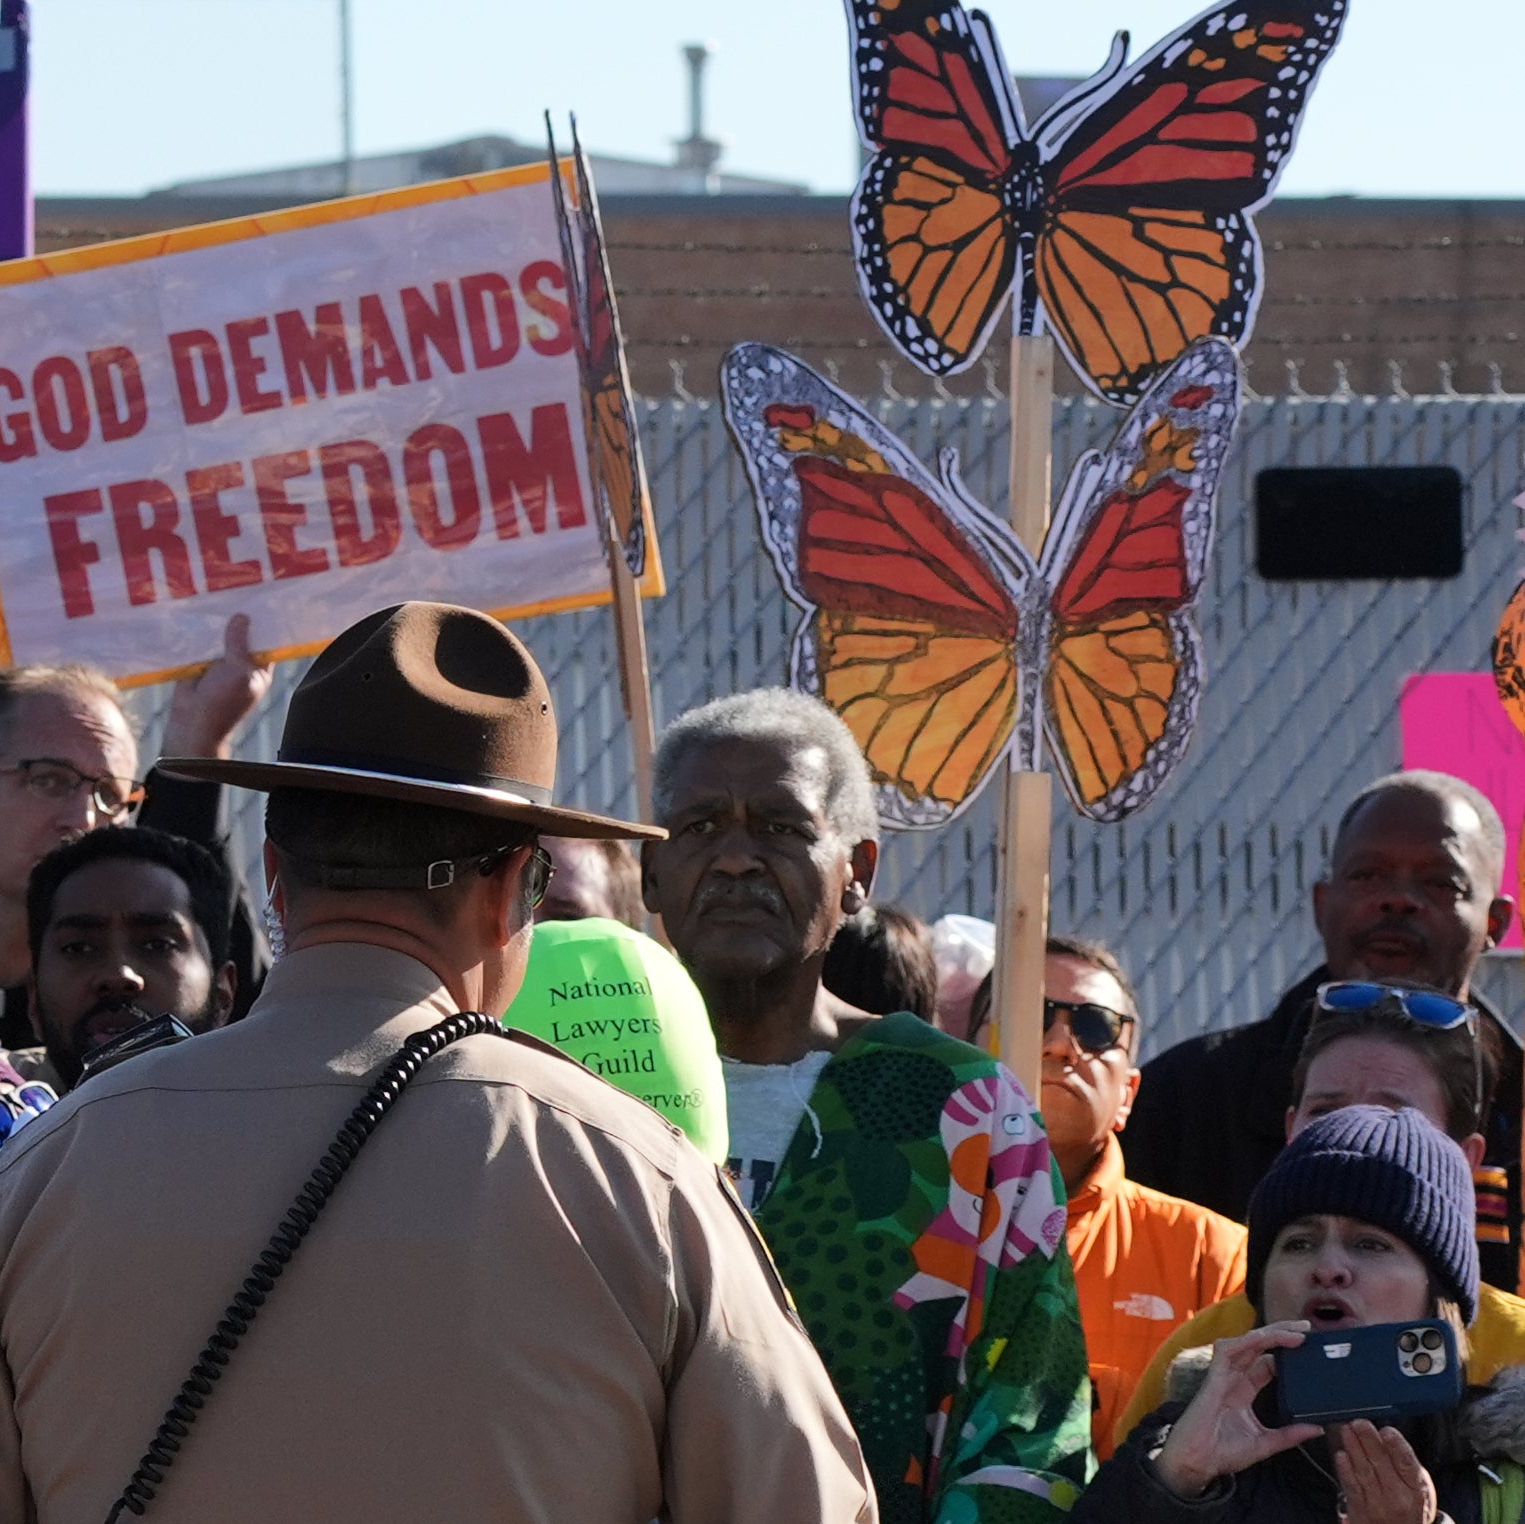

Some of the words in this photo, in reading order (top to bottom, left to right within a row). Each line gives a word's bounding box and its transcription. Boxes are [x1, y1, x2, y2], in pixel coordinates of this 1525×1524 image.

[169, 260, 577, 425] DEMANDS
[44, 402, 586, 619] FREEDOM
[549, 977, 653, 1007] National
[552, 1015, 663, 1047] Lawyers
[582, 1049, 656, 1076] Guild
